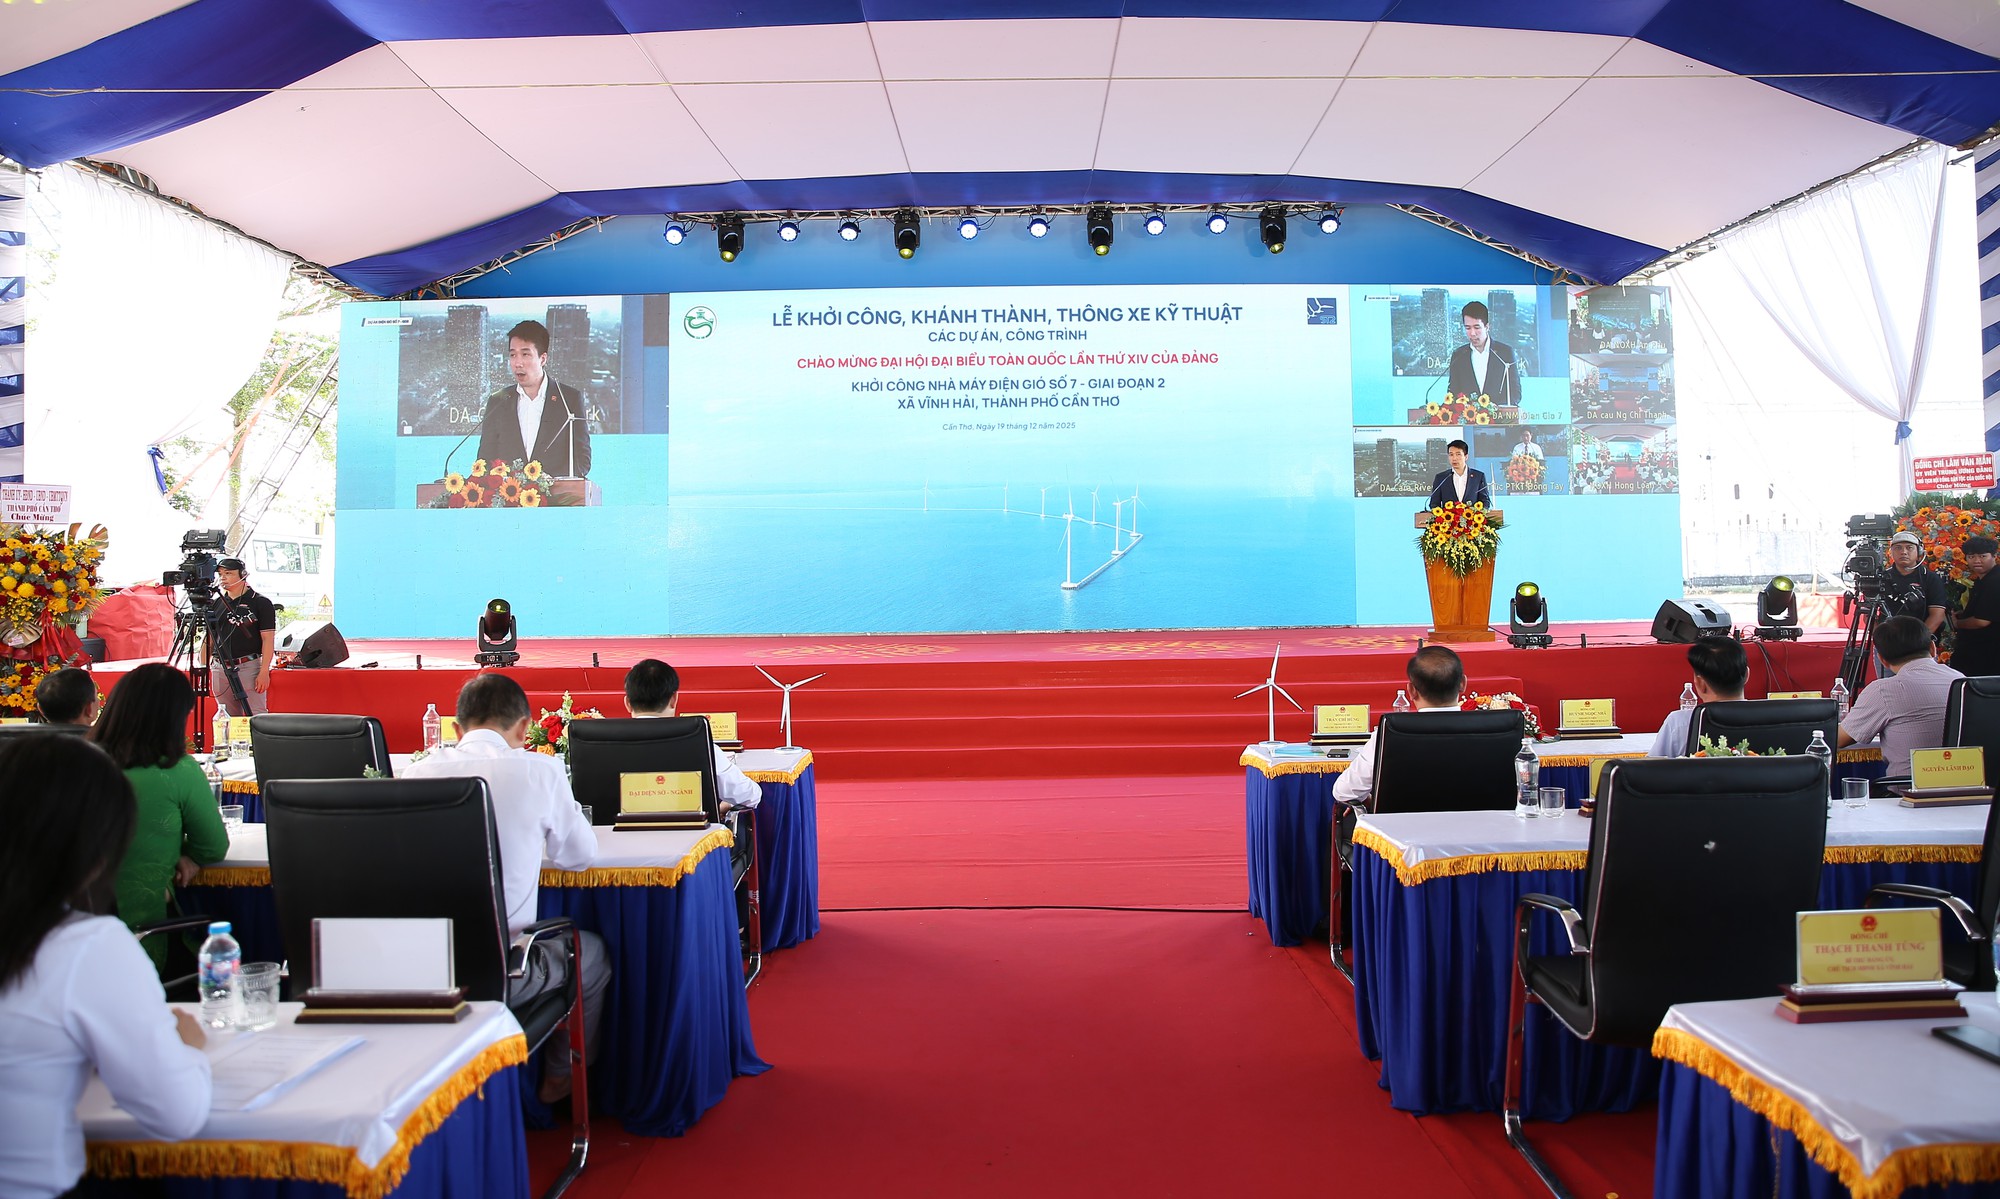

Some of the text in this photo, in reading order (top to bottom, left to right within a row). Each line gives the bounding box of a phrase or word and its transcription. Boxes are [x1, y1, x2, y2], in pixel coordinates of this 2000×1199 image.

[772, 303, 1243, 327] LỄ KHỞI CÔNG, KHÁNH THÀNH, THÔNG XE KỸ THUẬT
[928, 327, 1087, 344] CÁC DỰ ÁN, CÔNG TRÌNH
[797, 350, 1219, 370] CHÀO MỪNG ĐẠI HỘI ĐẠI BIỂU TOÀN QUỐC LẦN THỨ XIV CỦA ĐẢNG
[1427, 358, 1441, 369] DA
[851, 378, 884, 392] KHỞI
[886, 377, 926, 392] CÔNG
[928, 376, 956, 392] NHÀ
[958, 376, 986, 391] MÁY
[988, 376, 1020, 393] ĐIỆN
[1022, 376, 1046, 391] GIÓ
[1049, 374, 1068, 390] SỐ
[1070, 379, 1077, 390] 7
[1088, 378, 1114, 390] GIAI
[1117, 378, 1156, 392] ĐOẠN
[1157, 377, 1165, 389] 2
[898, 392, 1121, 410] XÃ VĨNH HẢI, THÀNH PHỐ CẦN THƠ
[450, 407, 470, 424] DA
[1616, 411, 1626, 420] Ng
[1007, 422, 1028, 431] tháng
[1915, 460, 1932, 469] ĐỒNG
[1946, 458, 1959, 467] LÂM
[1961, 457, 1974, 466] VĂN
[1551, 482, 1564, 491] Tay
[1615, 482, 1634, 491] Hong
[7, 503, 25, 511] THÀNH
[27, 502, 38, 512] PHỐ
[33, 514, 54, 522] Mừng
[1814, 944, 1852, 955] THẠCH
[1855, 943, 1892, 953] THANH
